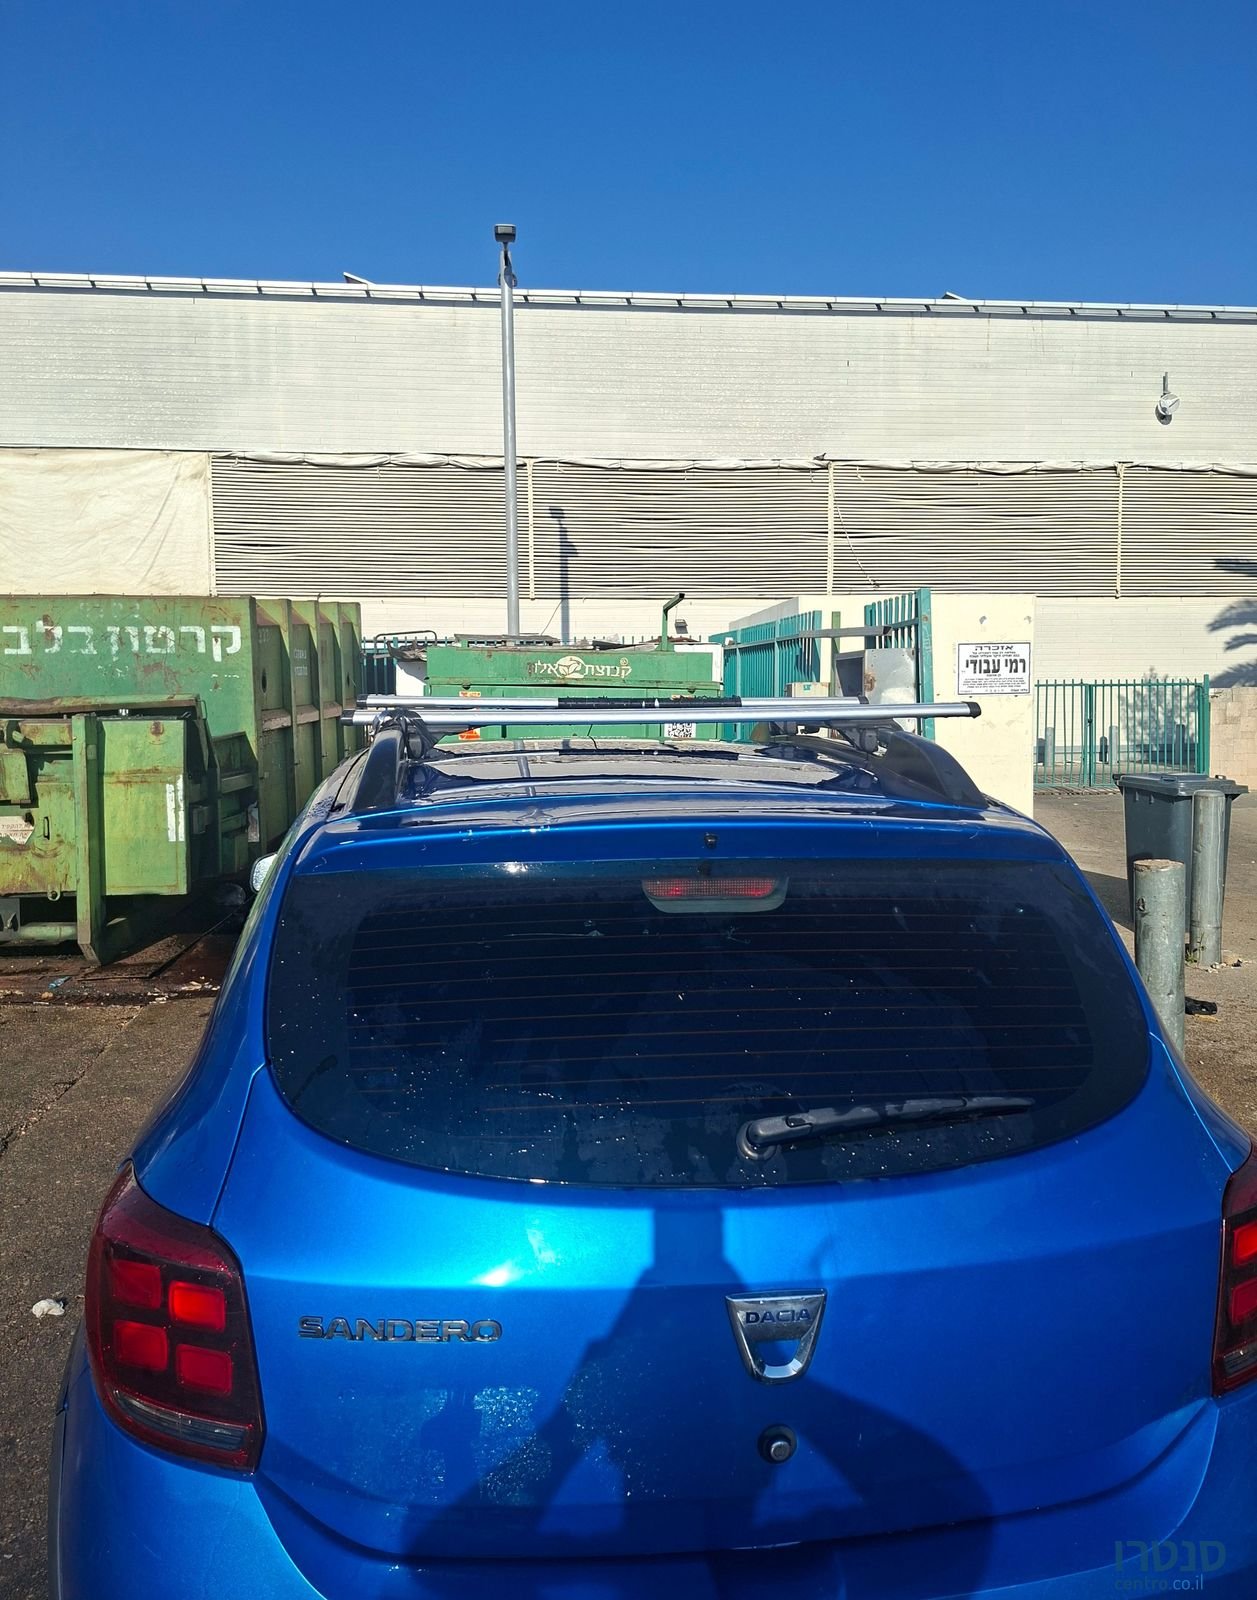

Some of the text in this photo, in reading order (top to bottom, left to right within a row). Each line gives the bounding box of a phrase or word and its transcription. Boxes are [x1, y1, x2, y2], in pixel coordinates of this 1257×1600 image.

[584, 663, 633, 679] קבוצת
[965, 658, 1027, 674] רמי עבודי
[745, 1308, 811, 1325] DACIA
[298, 1315, 503, 1343] SANDERO
